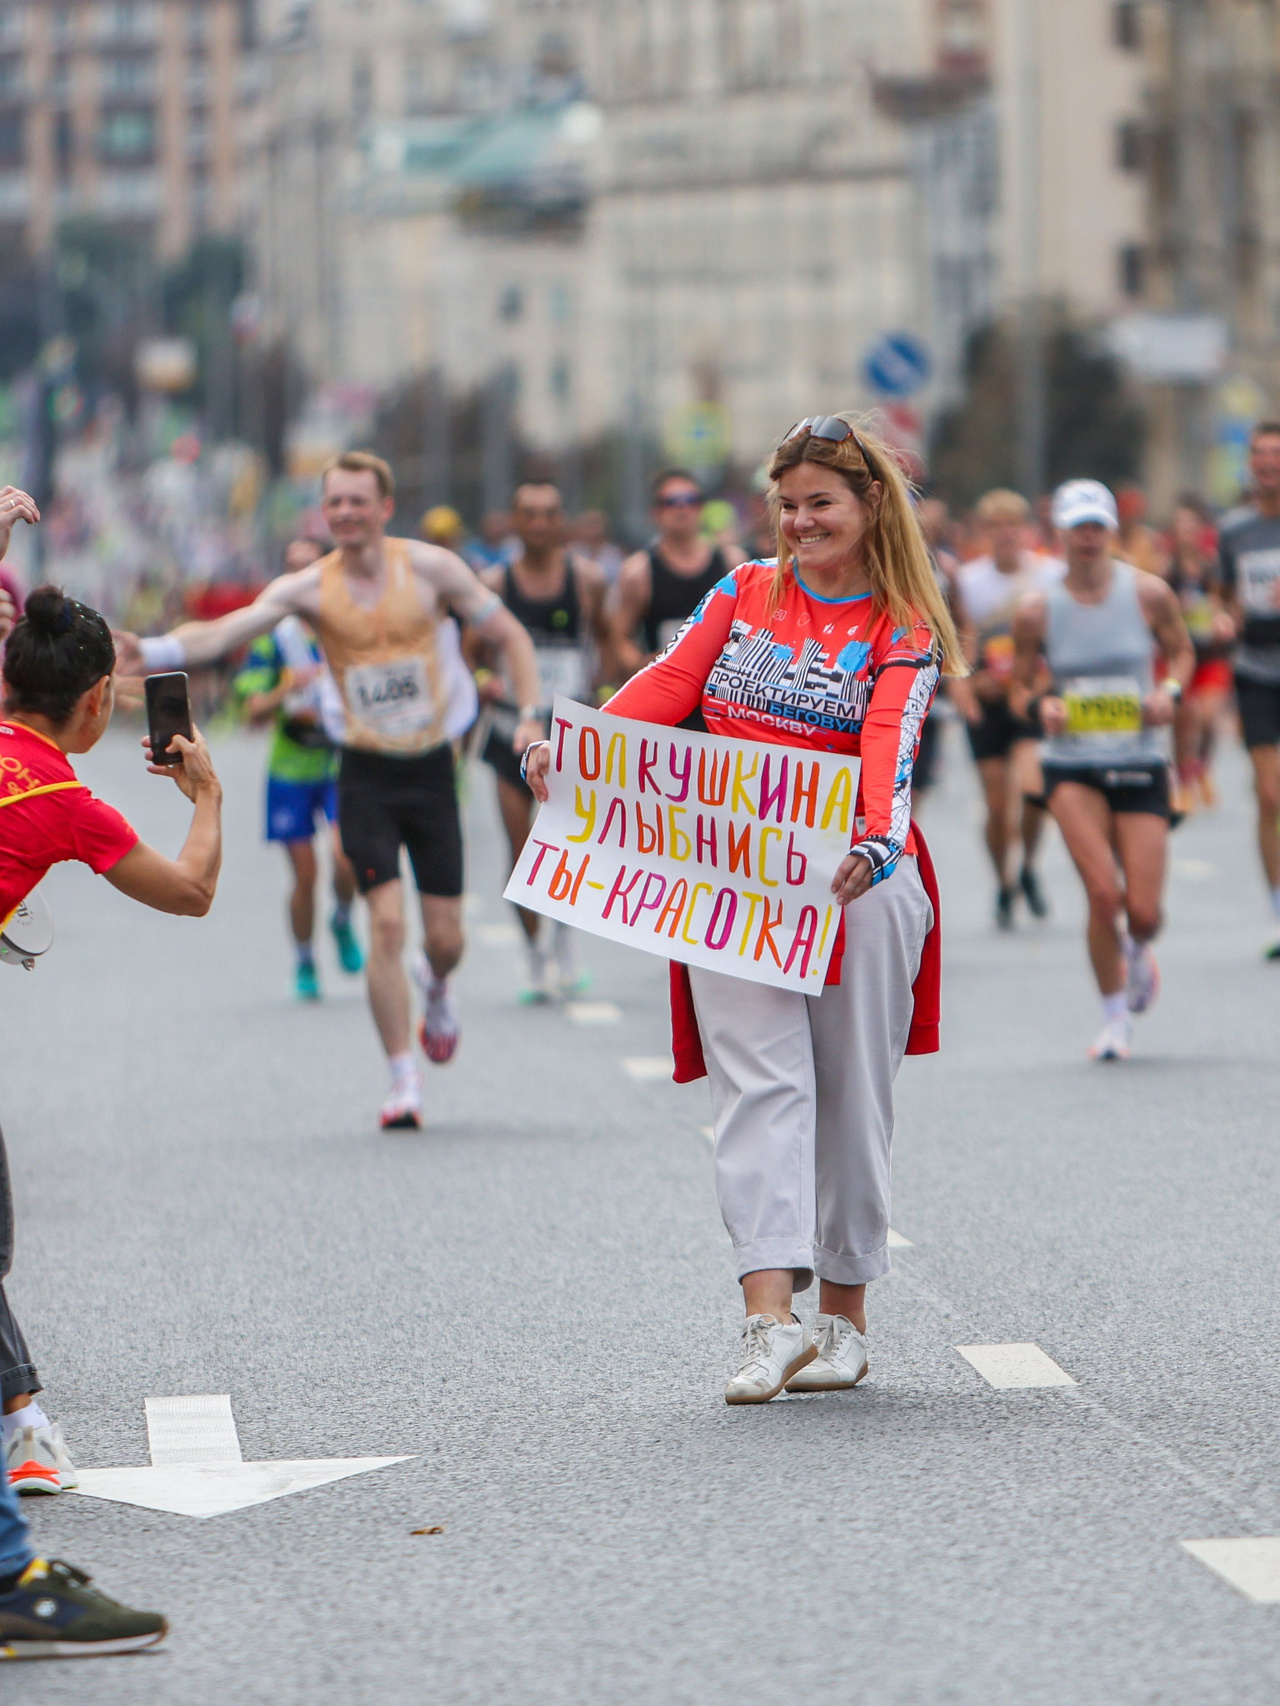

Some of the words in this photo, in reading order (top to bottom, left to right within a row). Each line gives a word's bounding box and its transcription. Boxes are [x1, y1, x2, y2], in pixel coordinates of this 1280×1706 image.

[709, 670, 857, 718] ПРОЕКТИРУЕМ
[727, 705, 817, 736] МОСКВУ
[565, 784, 807, 887] УЛЫБНИСЬ
[526, 838, 833, 979] ТЫ-КРАСОТКА!
